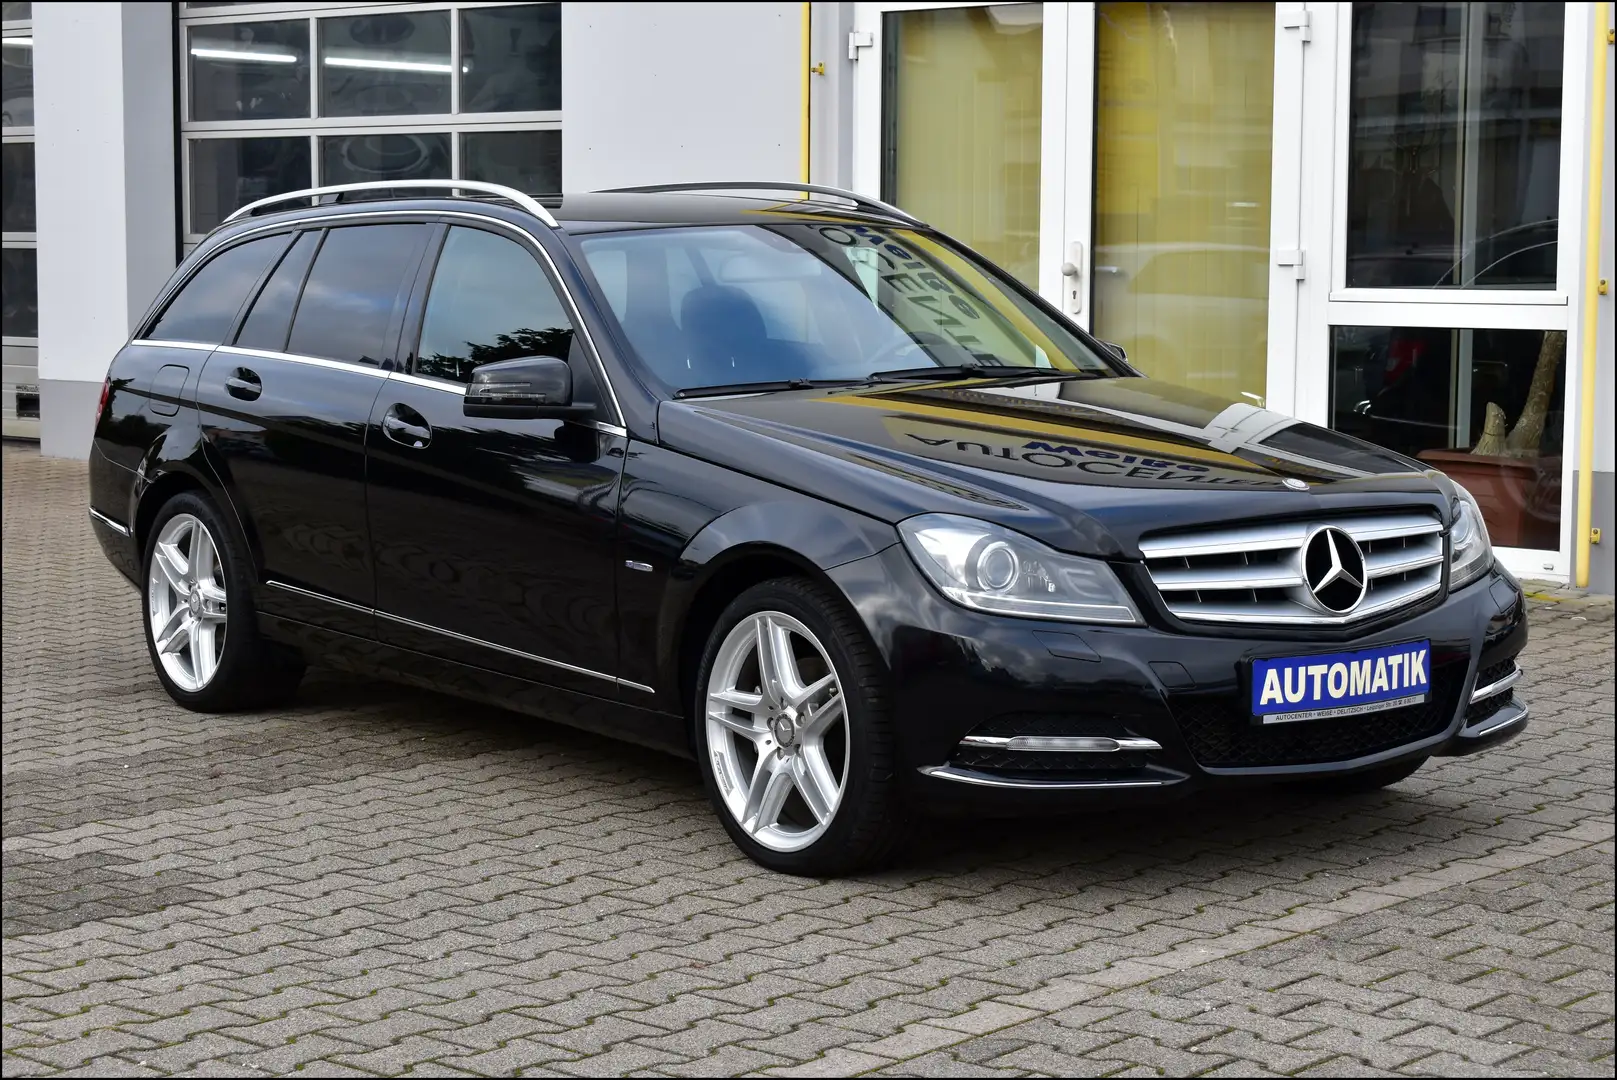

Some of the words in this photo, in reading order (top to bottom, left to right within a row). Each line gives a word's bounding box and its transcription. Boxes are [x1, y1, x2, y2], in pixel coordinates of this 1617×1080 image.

[1259, 649, 1427, 706] AUTOMATIK
[1275, 712, 1312, 721] AUTOCENTER
[1337, 706, 1363, 715] DELITZSCH
